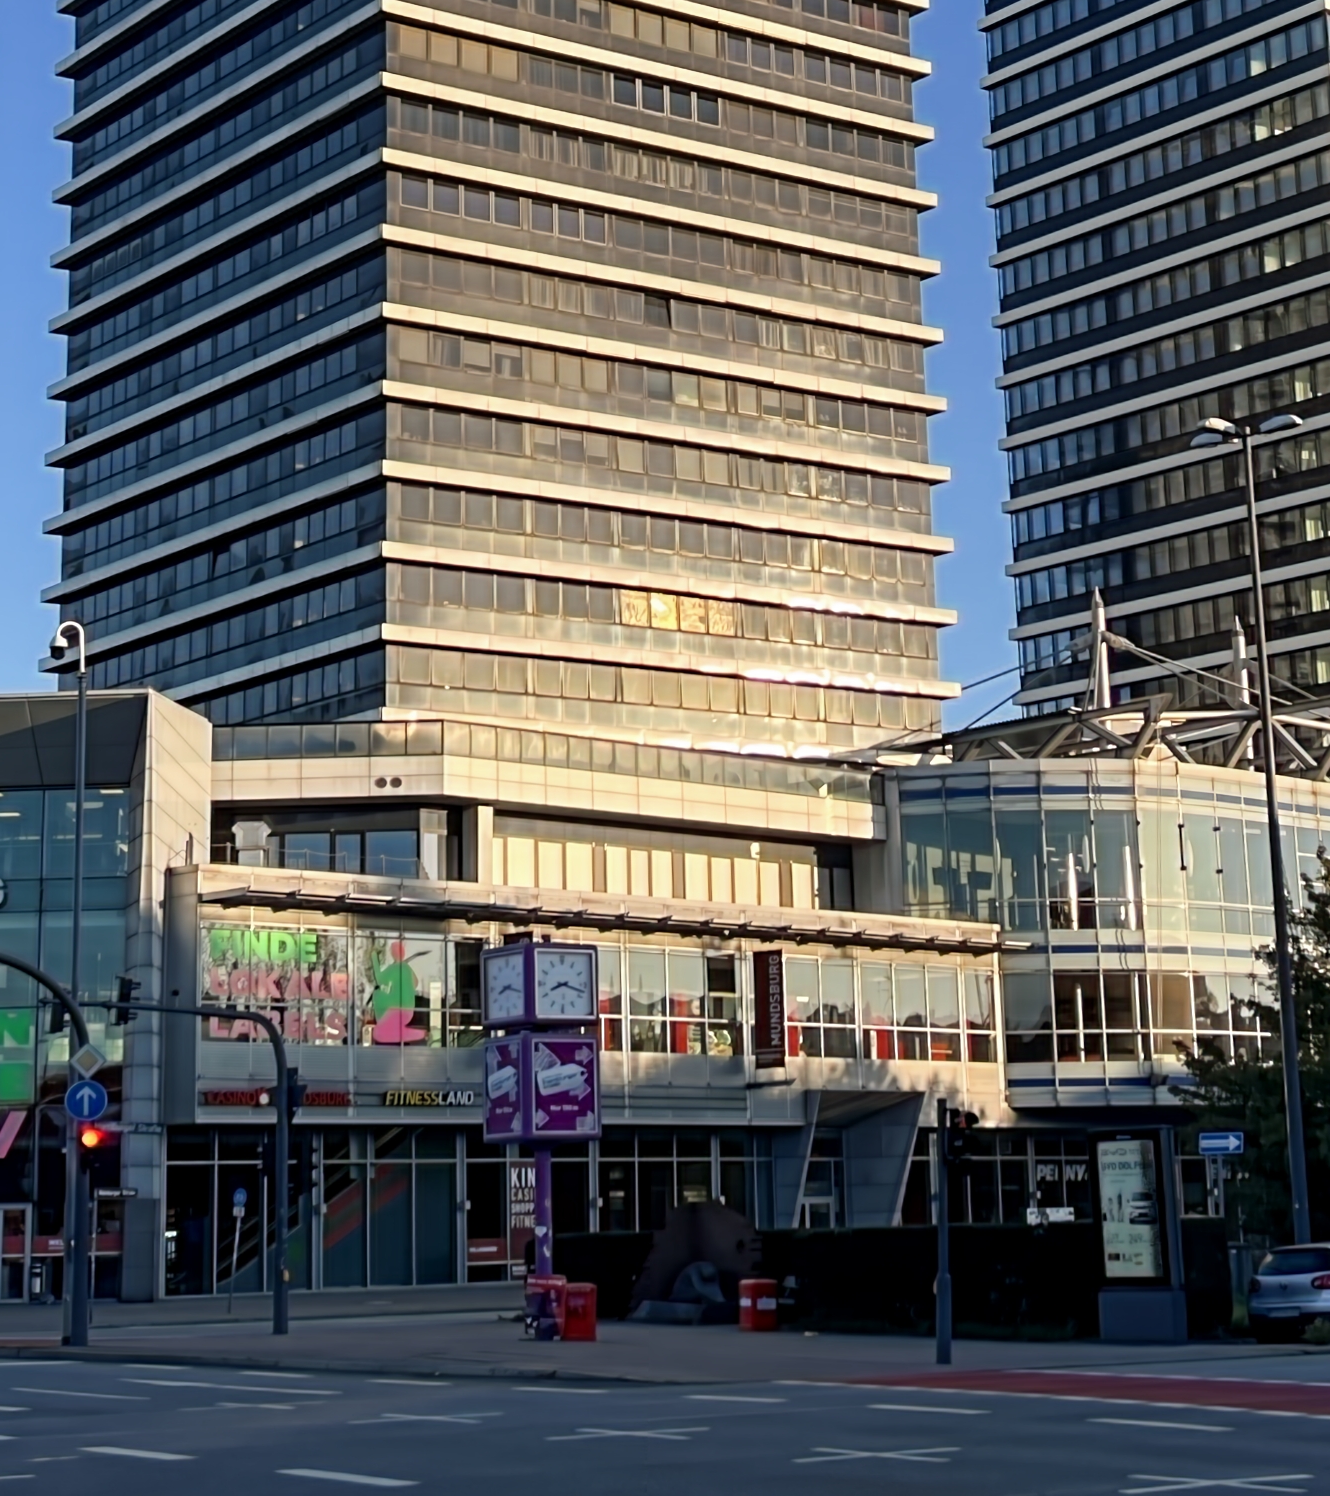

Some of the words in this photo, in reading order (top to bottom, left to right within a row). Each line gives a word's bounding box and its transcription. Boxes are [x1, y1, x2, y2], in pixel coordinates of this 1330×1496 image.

[209, 930, 318, 963] FINDE
[209, 967, 349, 999] LOKALE
[769, 955, 781, 1046] MUNDSBURG
[209, 1010, 348, 1040] LABELS
[207, 1091, 257, 1105] CASINO
[385, 1090, 474, 1106] FITNESSLAND
